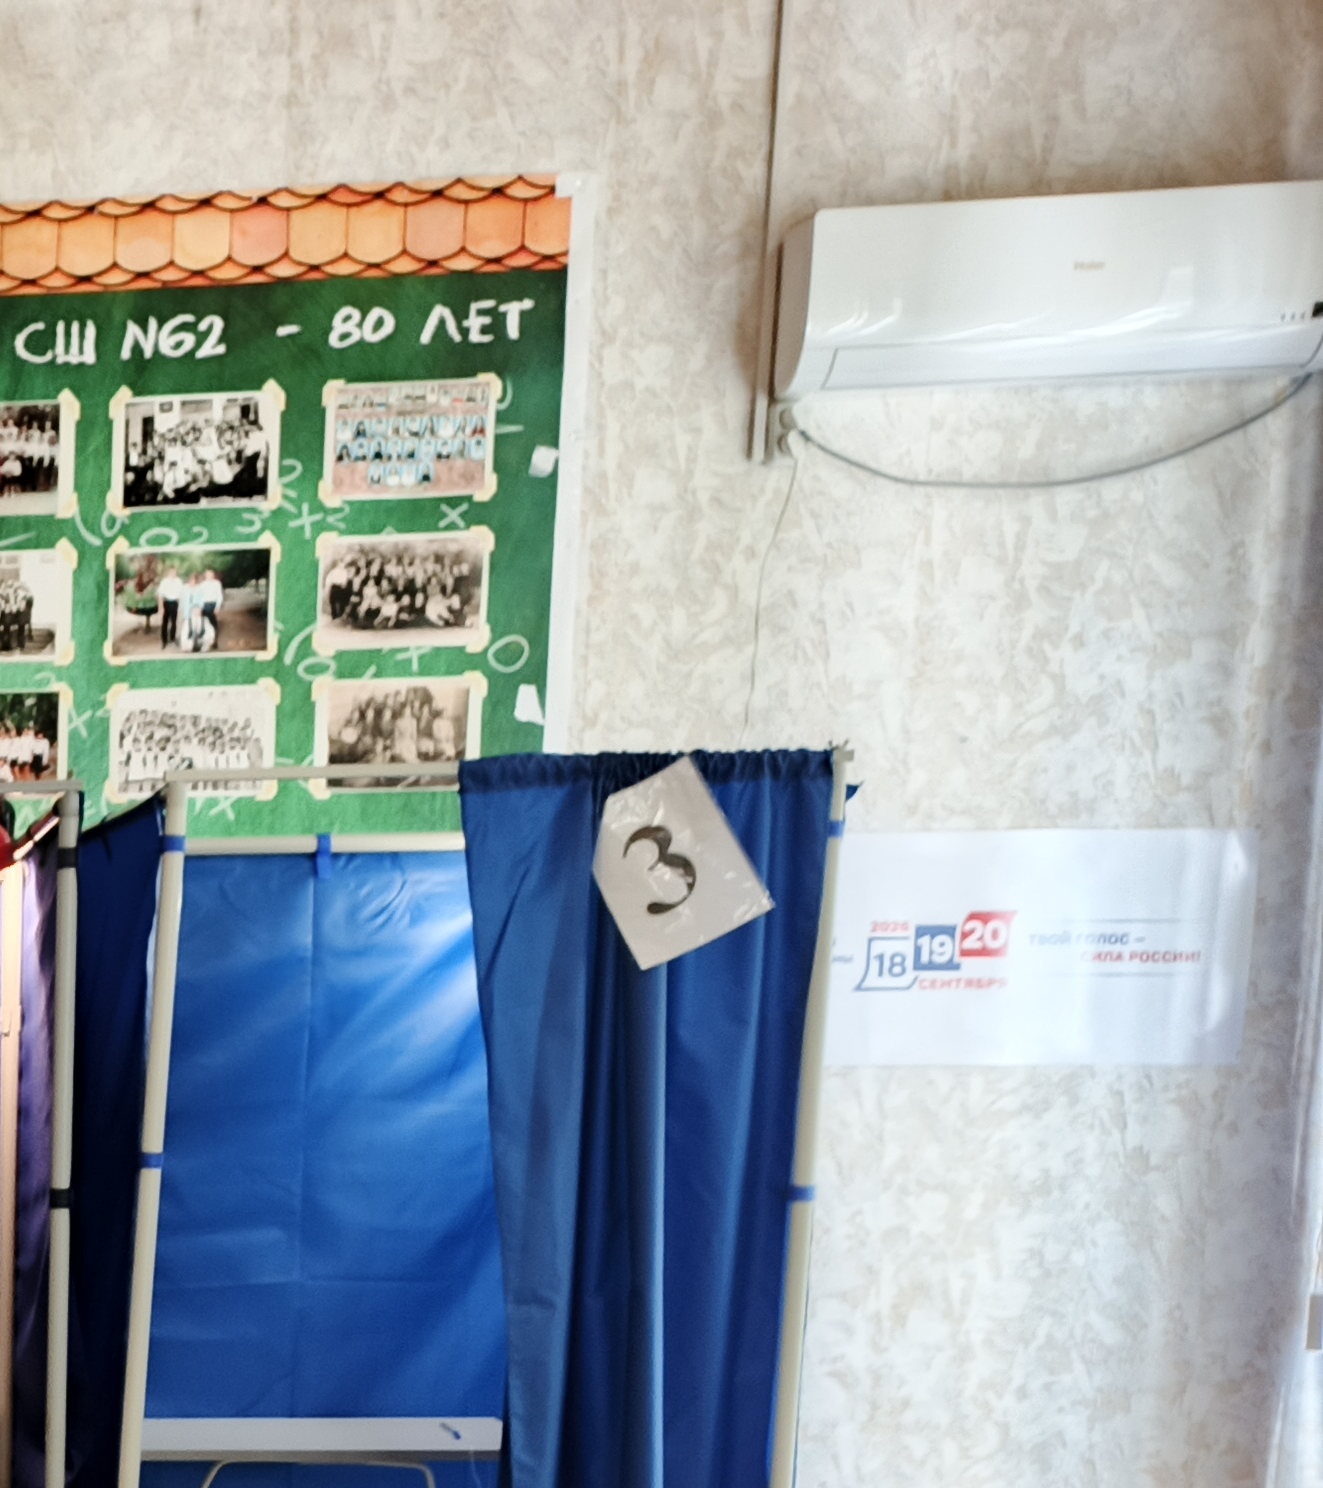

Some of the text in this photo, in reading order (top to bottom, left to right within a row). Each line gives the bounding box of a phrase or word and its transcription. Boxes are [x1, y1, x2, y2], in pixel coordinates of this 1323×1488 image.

[14, 318, 97, 365] СШ
[119, 313, 227, 361] N62
[328, 304, 396, 350] 80
[419, 297, 535, 346] ЛЕТ
[622, 825, 697, 915] 3
[873, 919, 1008, 978] 18 19 20
